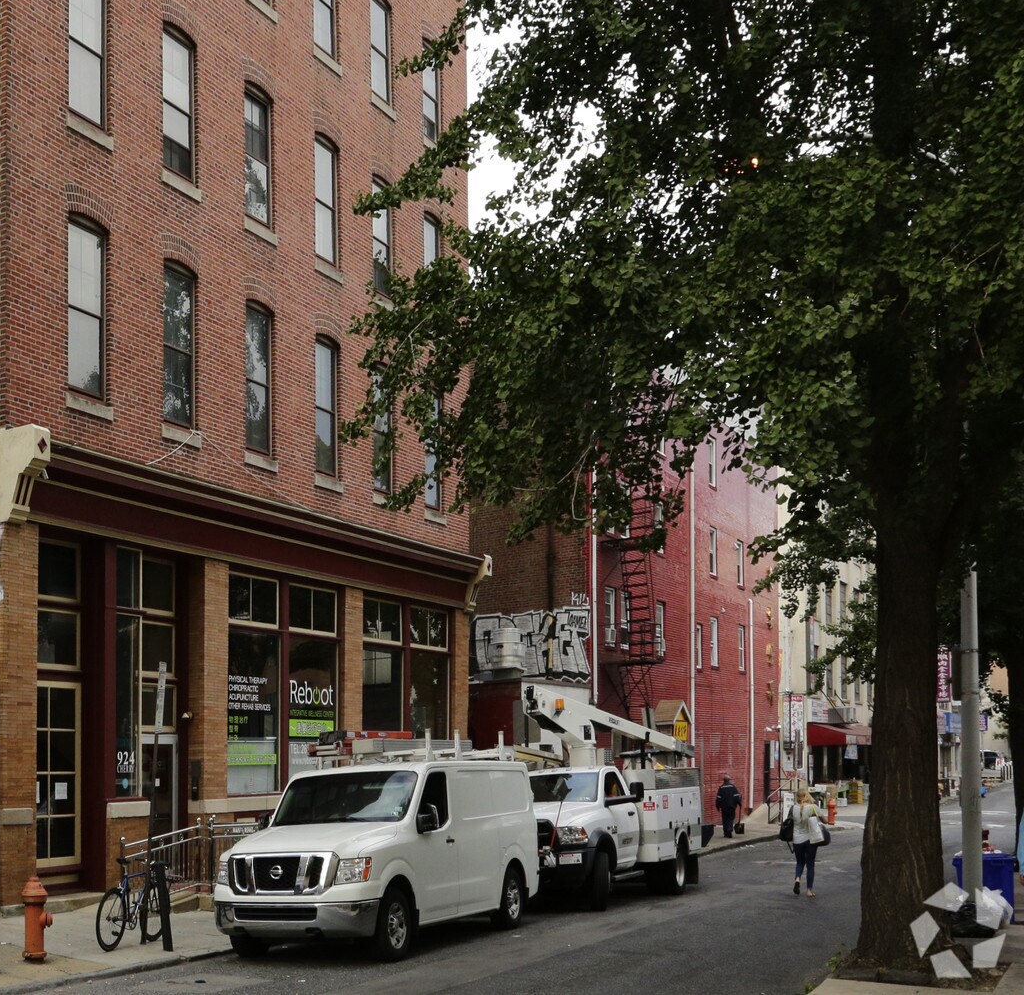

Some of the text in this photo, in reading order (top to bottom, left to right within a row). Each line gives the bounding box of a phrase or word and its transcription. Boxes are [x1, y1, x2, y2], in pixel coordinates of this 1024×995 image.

[229, 675, 268, 684] PHYSICAL THERAPY
[228, 684, 259, 692] CHIROPRACTIC
[289, 679, 334, 706] Reboot
[229, 693, 259, 701] ACUPUNCTURE
[228, 702, 271, 711] OTHER REHAB SERVICES
[117, 751, 135, 765] 924
[117, 765, 135, 774] CHERRY
